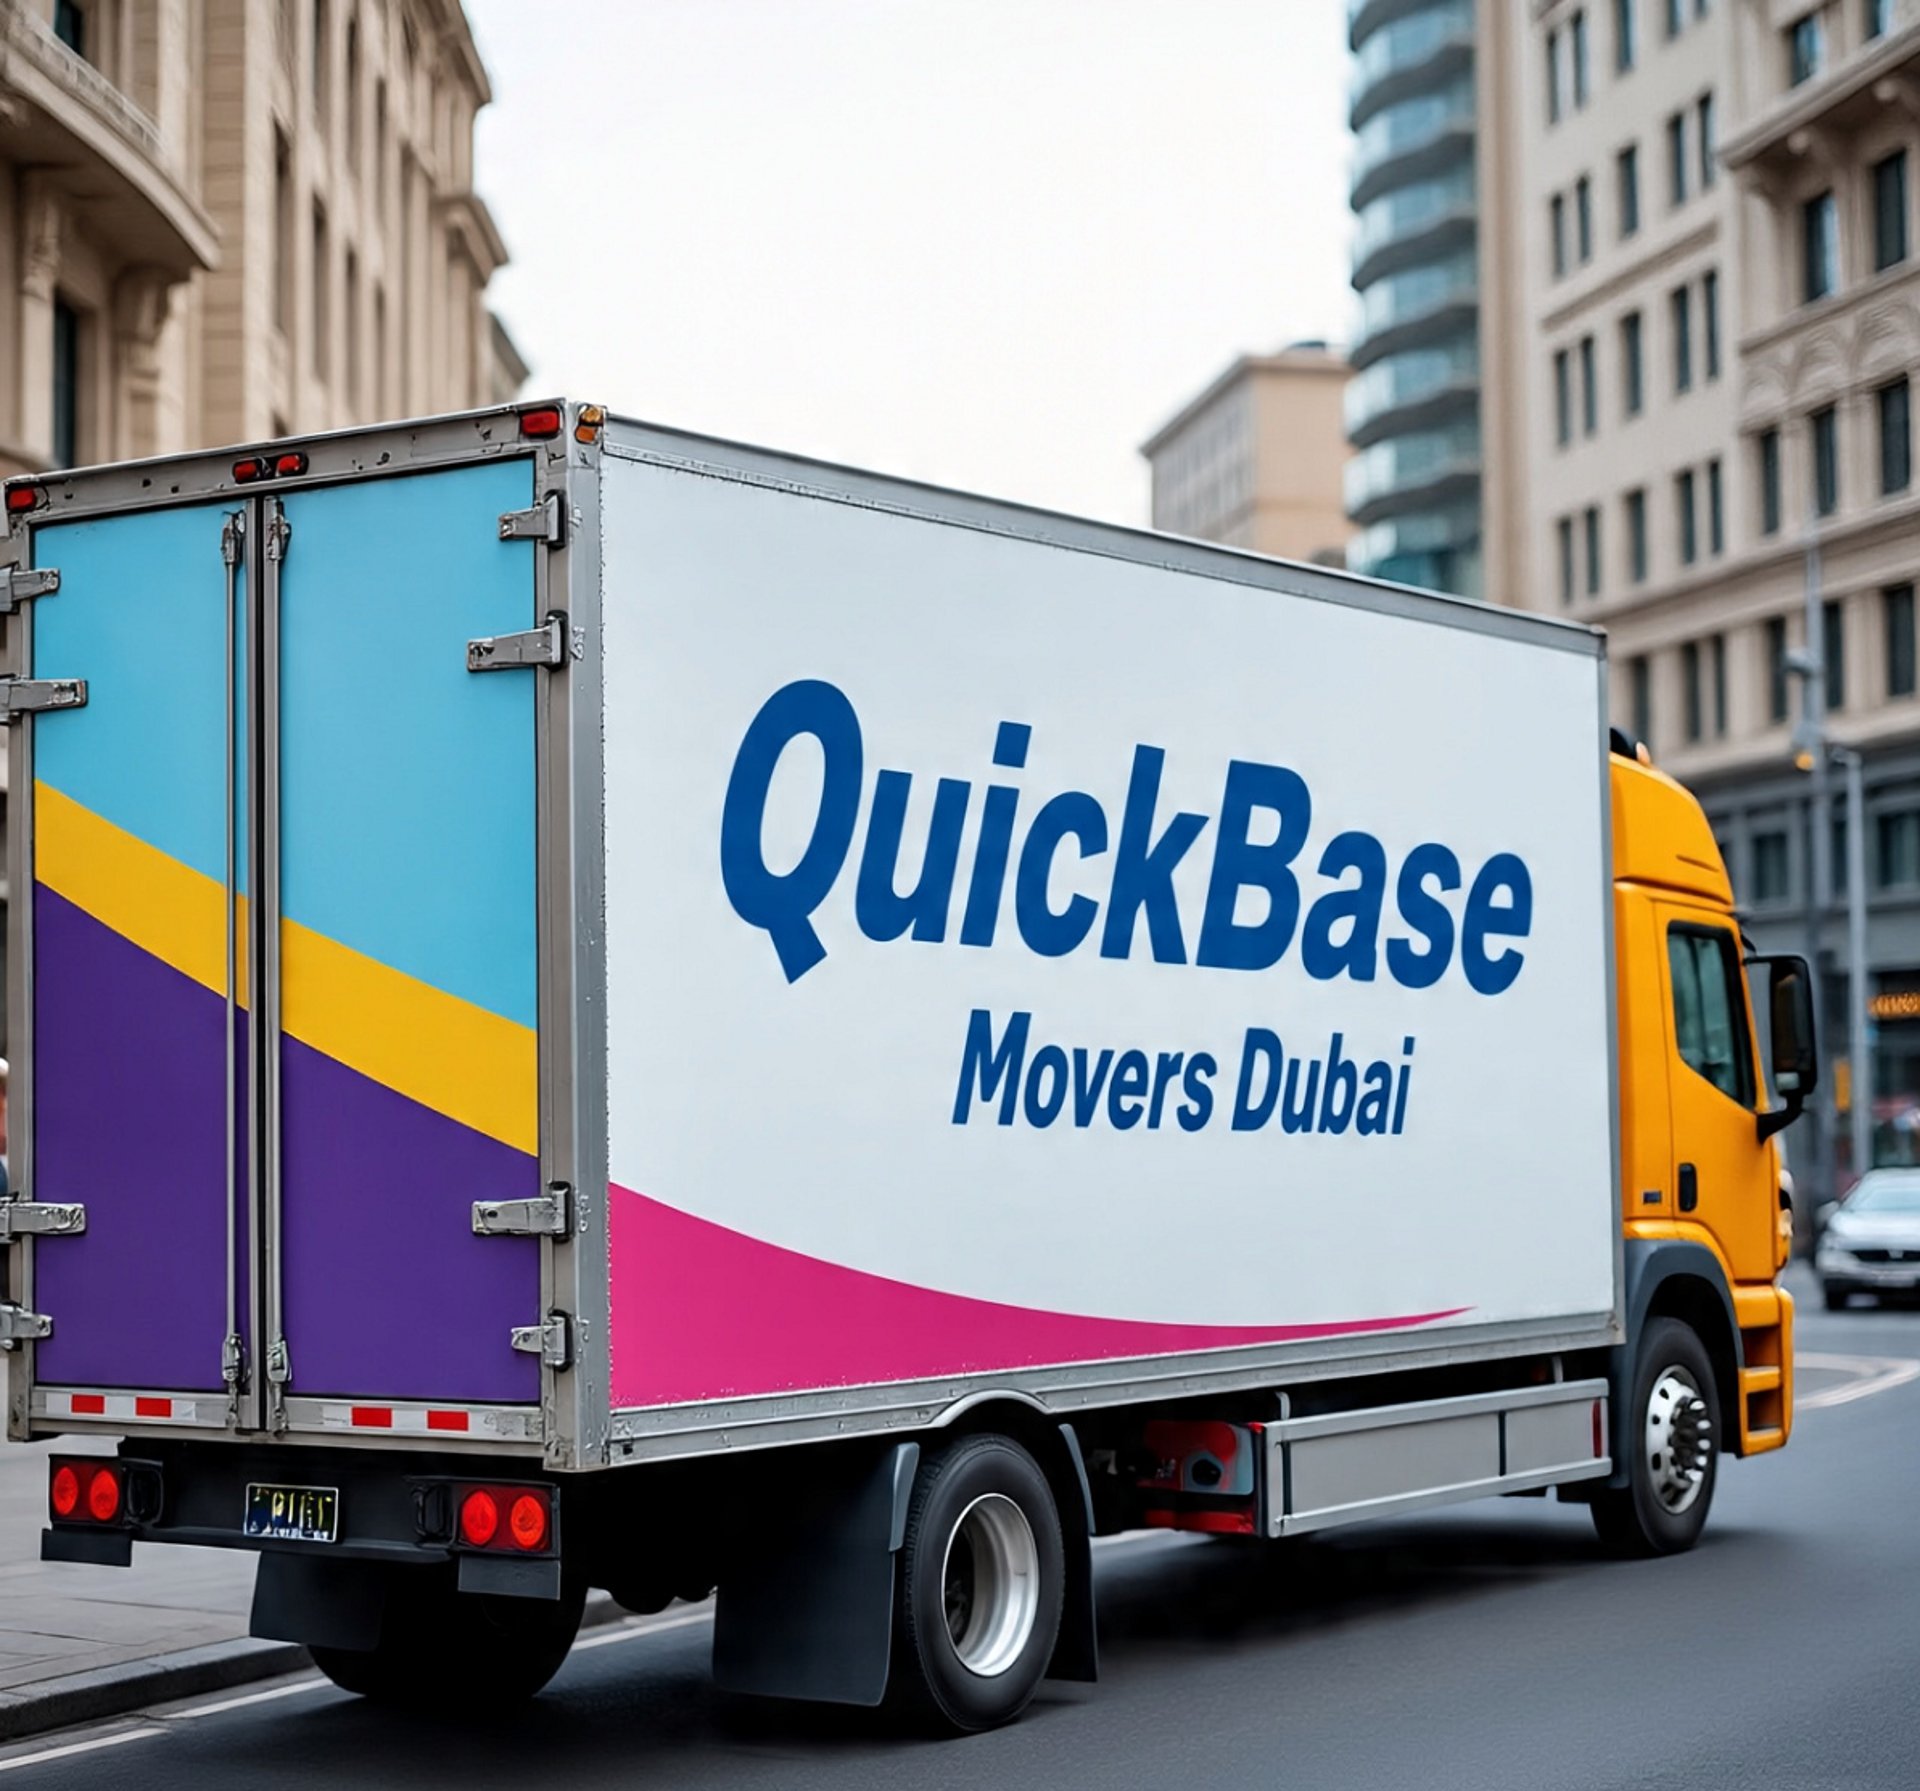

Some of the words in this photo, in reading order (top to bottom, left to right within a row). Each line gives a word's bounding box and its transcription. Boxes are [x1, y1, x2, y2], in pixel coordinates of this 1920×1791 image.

[721, 680, 1532, 996] QuickBase
[952, 1009, 1217, 1132] Movers
[1231, 1028, 1415, 1137] Dubai
